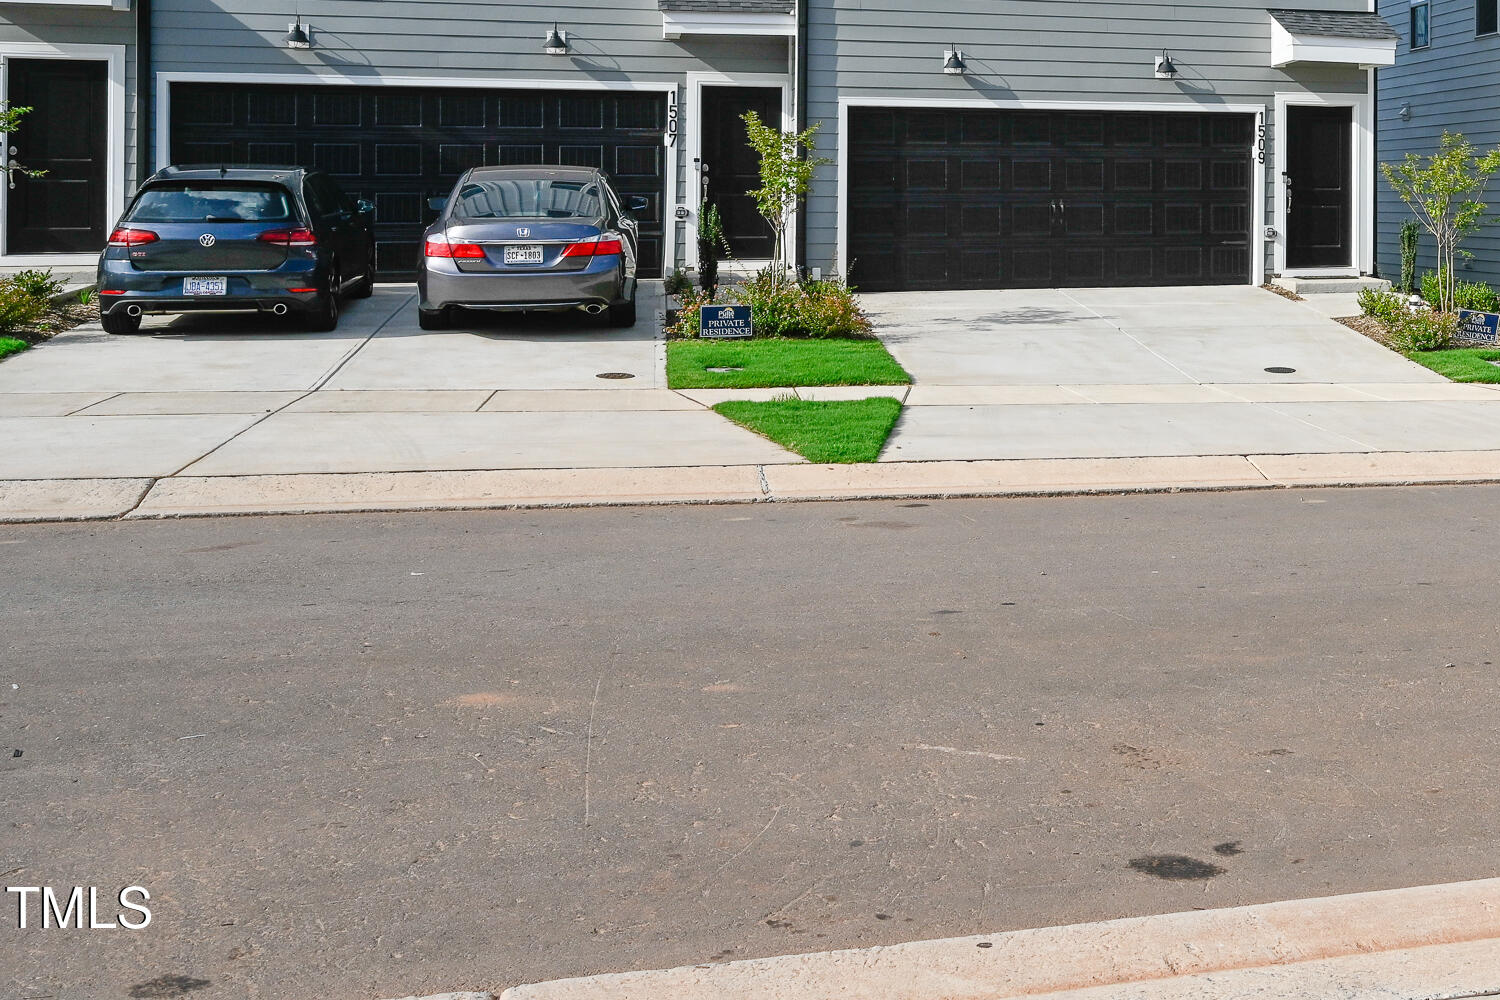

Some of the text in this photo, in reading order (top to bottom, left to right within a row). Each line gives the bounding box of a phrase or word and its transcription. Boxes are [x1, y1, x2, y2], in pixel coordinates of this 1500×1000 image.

[669, 90, 678, 148] 1507
[1258, 111, 1266, 165] 1509
[708, 319, 745, 328] PRIVATE
[1463, 323, 1492, 334] PRIVATE
[702, 327, 750, 336] RESIDENCE
[1455, 330, 1495, 341] RESIDENCE
